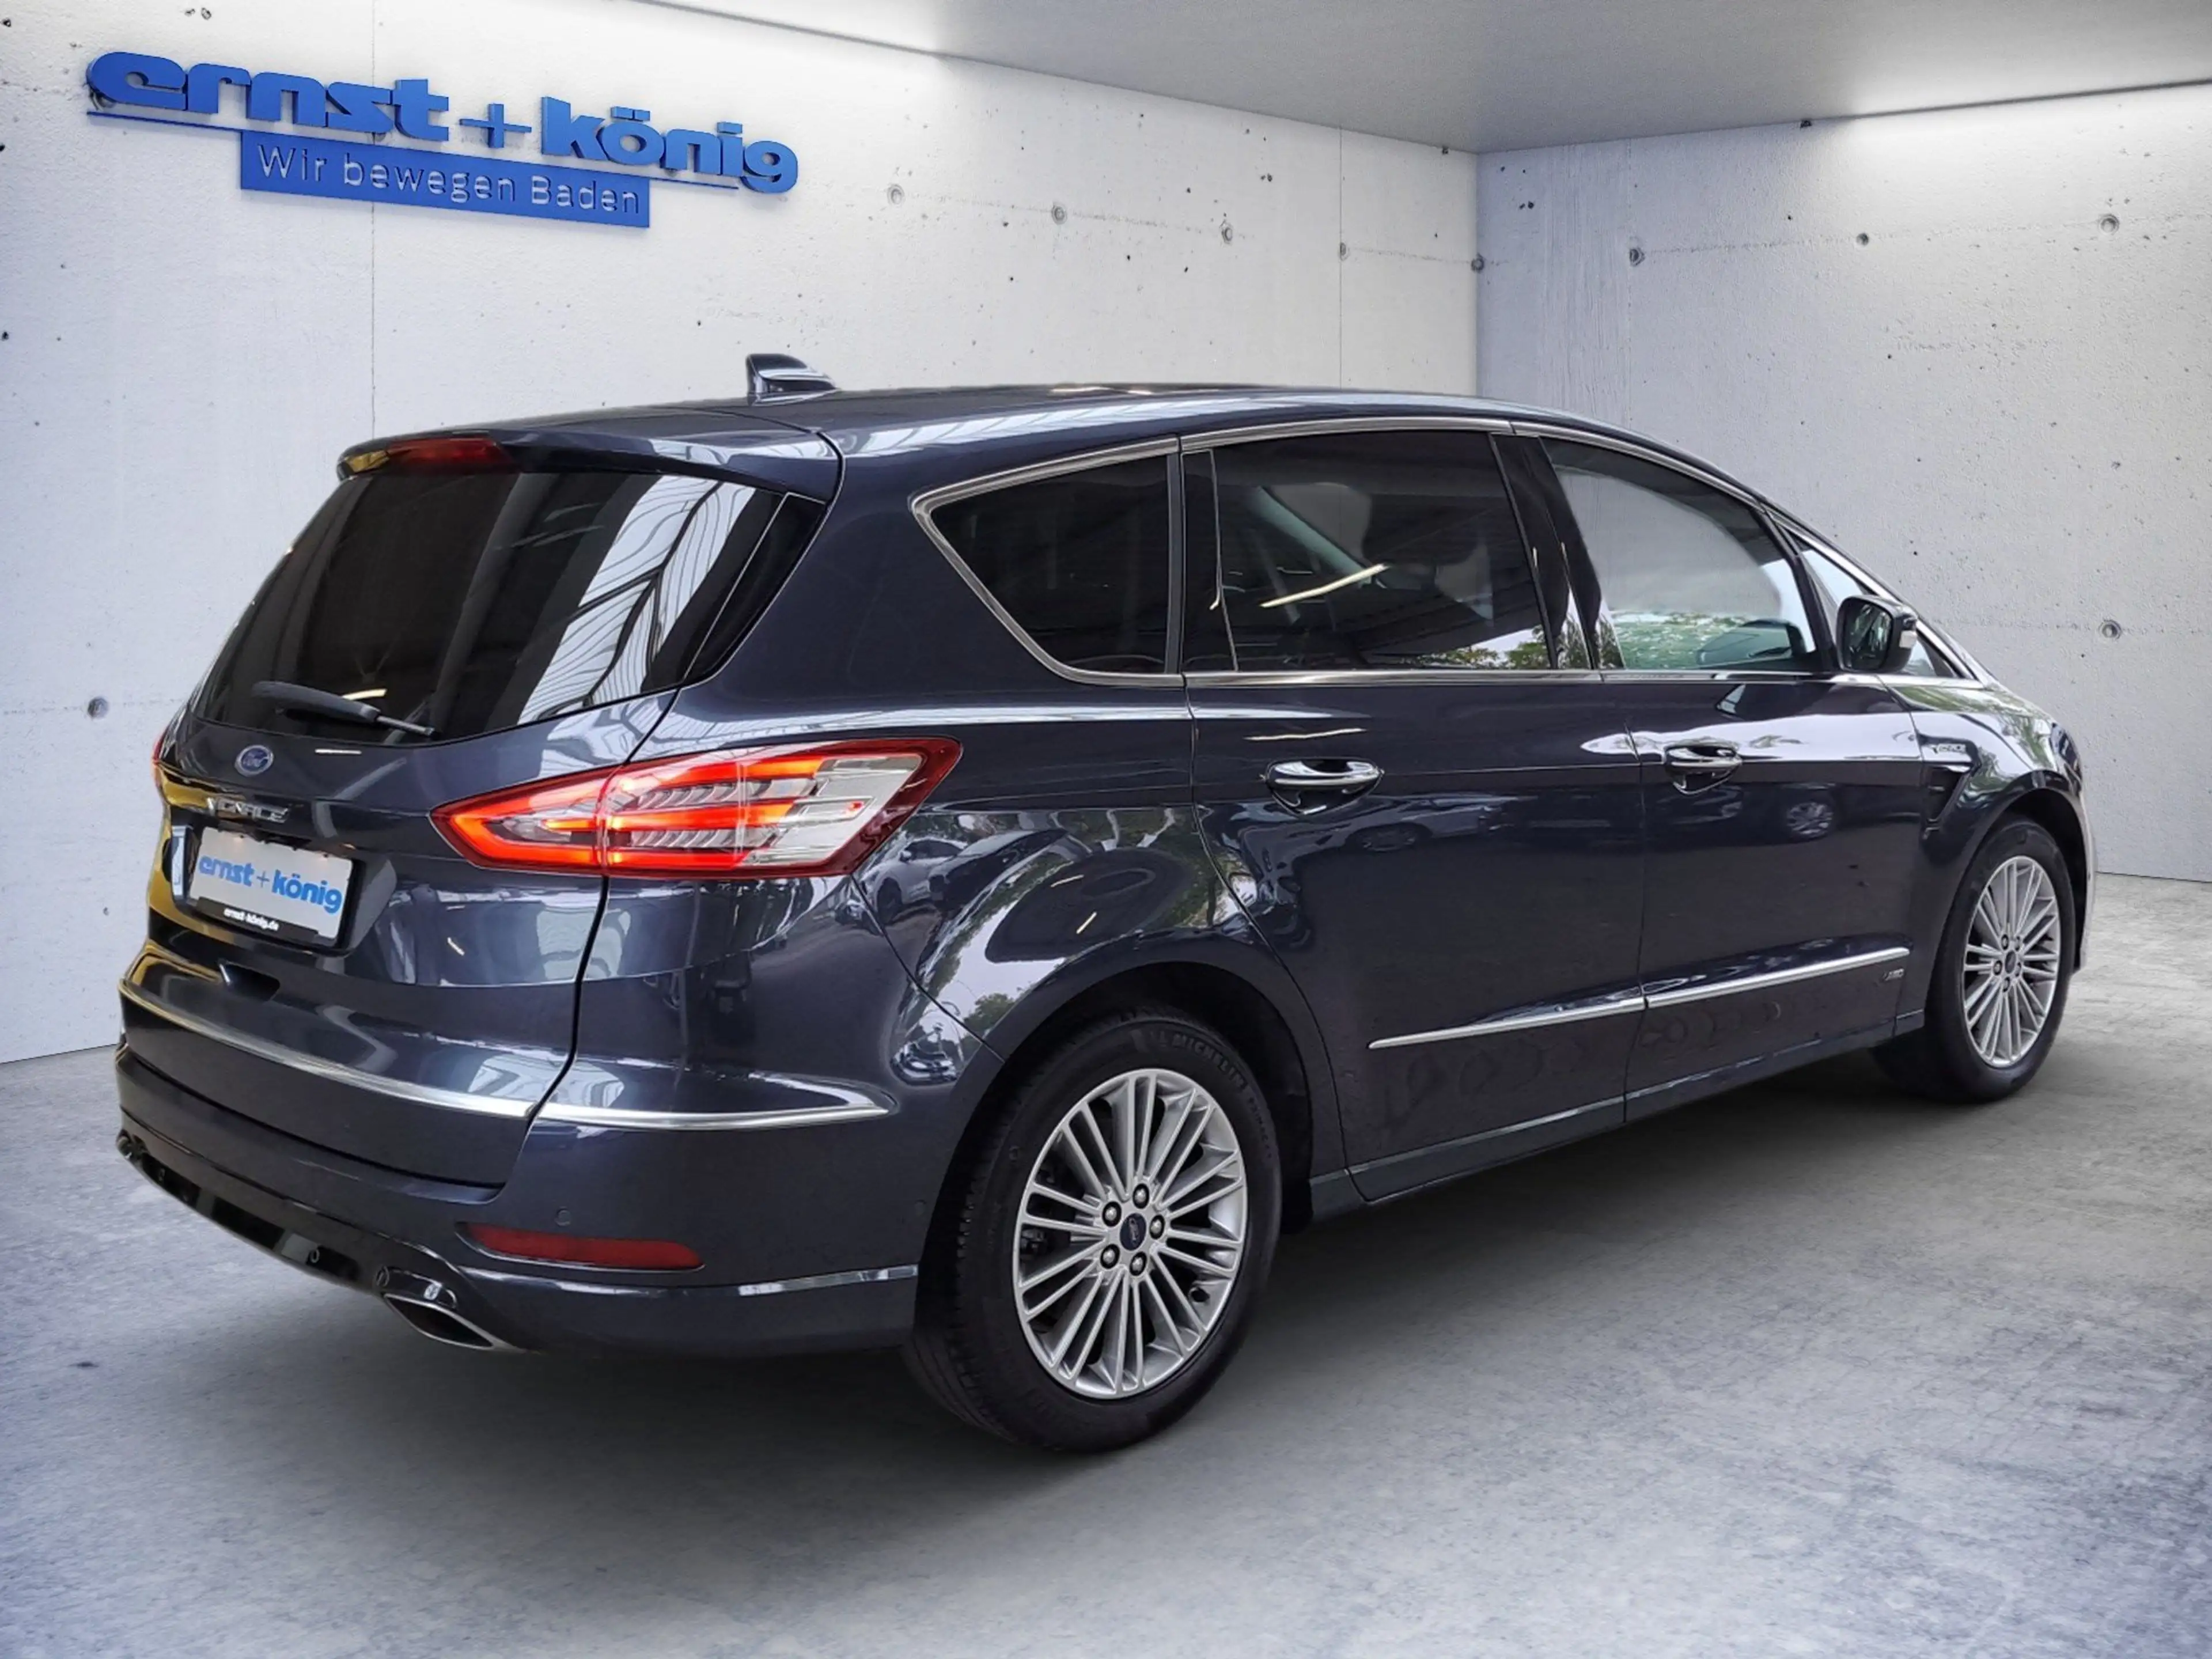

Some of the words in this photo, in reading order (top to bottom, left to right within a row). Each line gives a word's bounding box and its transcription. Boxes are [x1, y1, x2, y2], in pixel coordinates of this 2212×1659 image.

[257, 144, 327, 183] Wir
[344, 153, 515, 203] bewegen
[531, 175, 639, 214] Baden
